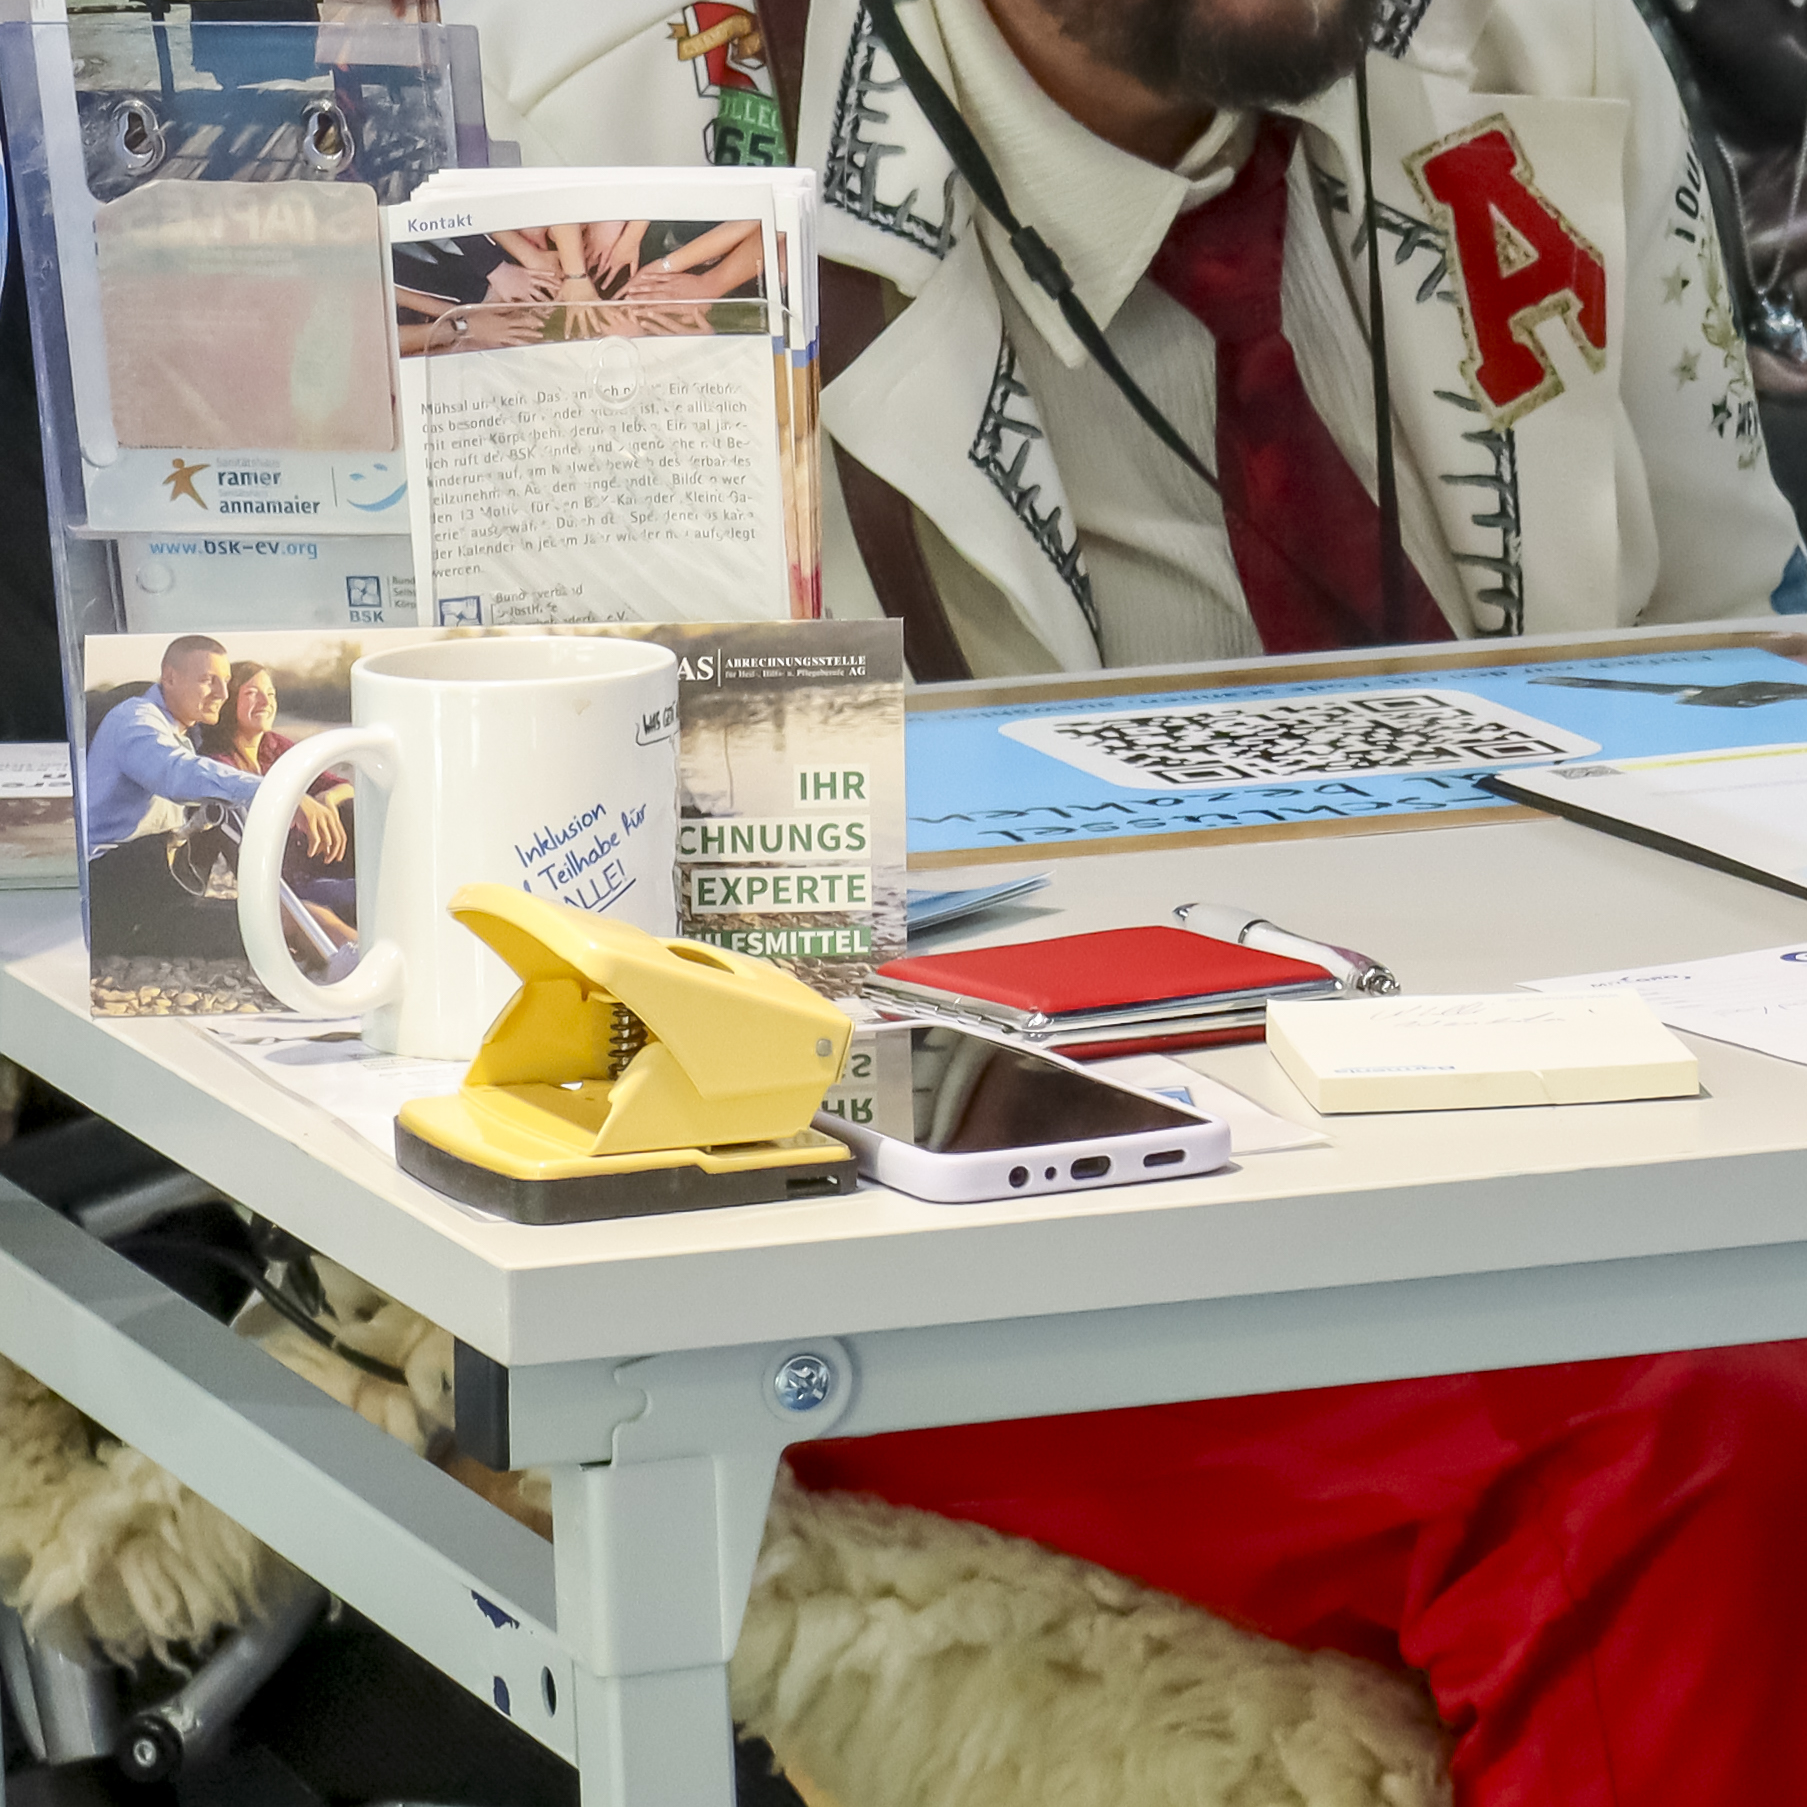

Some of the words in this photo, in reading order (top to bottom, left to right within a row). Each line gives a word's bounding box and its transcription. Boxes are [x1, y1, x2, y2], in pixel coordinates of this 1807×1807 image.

[407, 212, 473, 233] Kontakt
[1406, 118, 1606, 417] A
[218, 497, 321, 515] annamaier
[149, 539, 319, 560] www.bsk-ev.org
[350, 610, 384, 623] BSK
[725, 655, 866, 668] ABRECHNUNGSSTELLE
[849, 667, 866, 676] AG
[800, 770, 866, 801] IHR
[910, 783, 1372, 825] bezahlen
[514, 802, 607, 869] Inklusion
[537, 830, 621, 890] Teilhabe
[620, 803, 648, 837] für
[697, 873, 867, 907] EXPERTE
